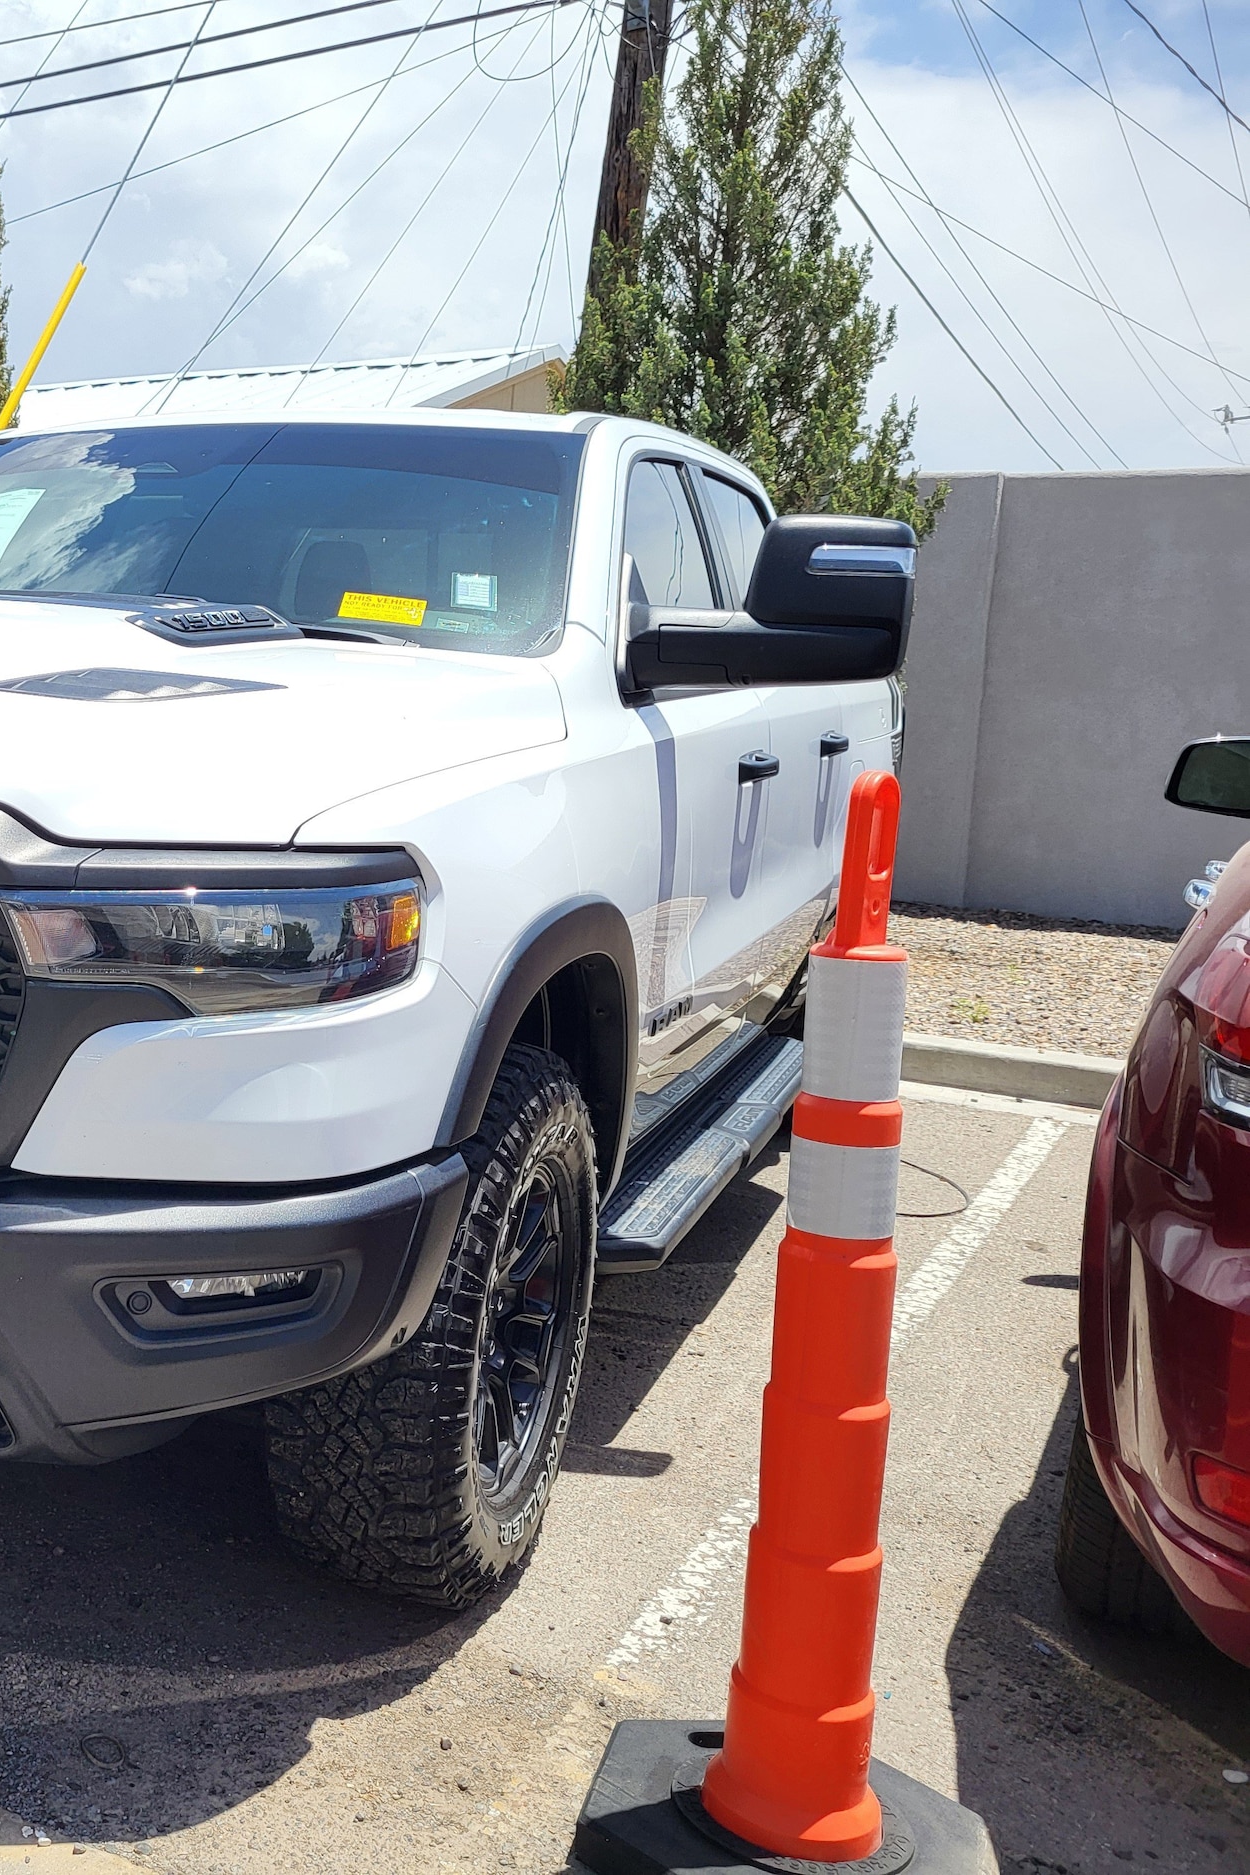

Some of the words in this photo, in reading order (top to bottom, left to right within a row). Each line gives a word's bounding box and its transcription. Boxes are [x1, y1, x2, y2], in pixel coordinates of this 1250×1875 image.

[347, 594, 372, 602] THIS
[376, 597, 424, 608] VEHICLE
[172, 609, 246, 630] 1500
[647, 994, 694, 1037] RAM
[499, 1313, 590, 1546] WRANGLER
